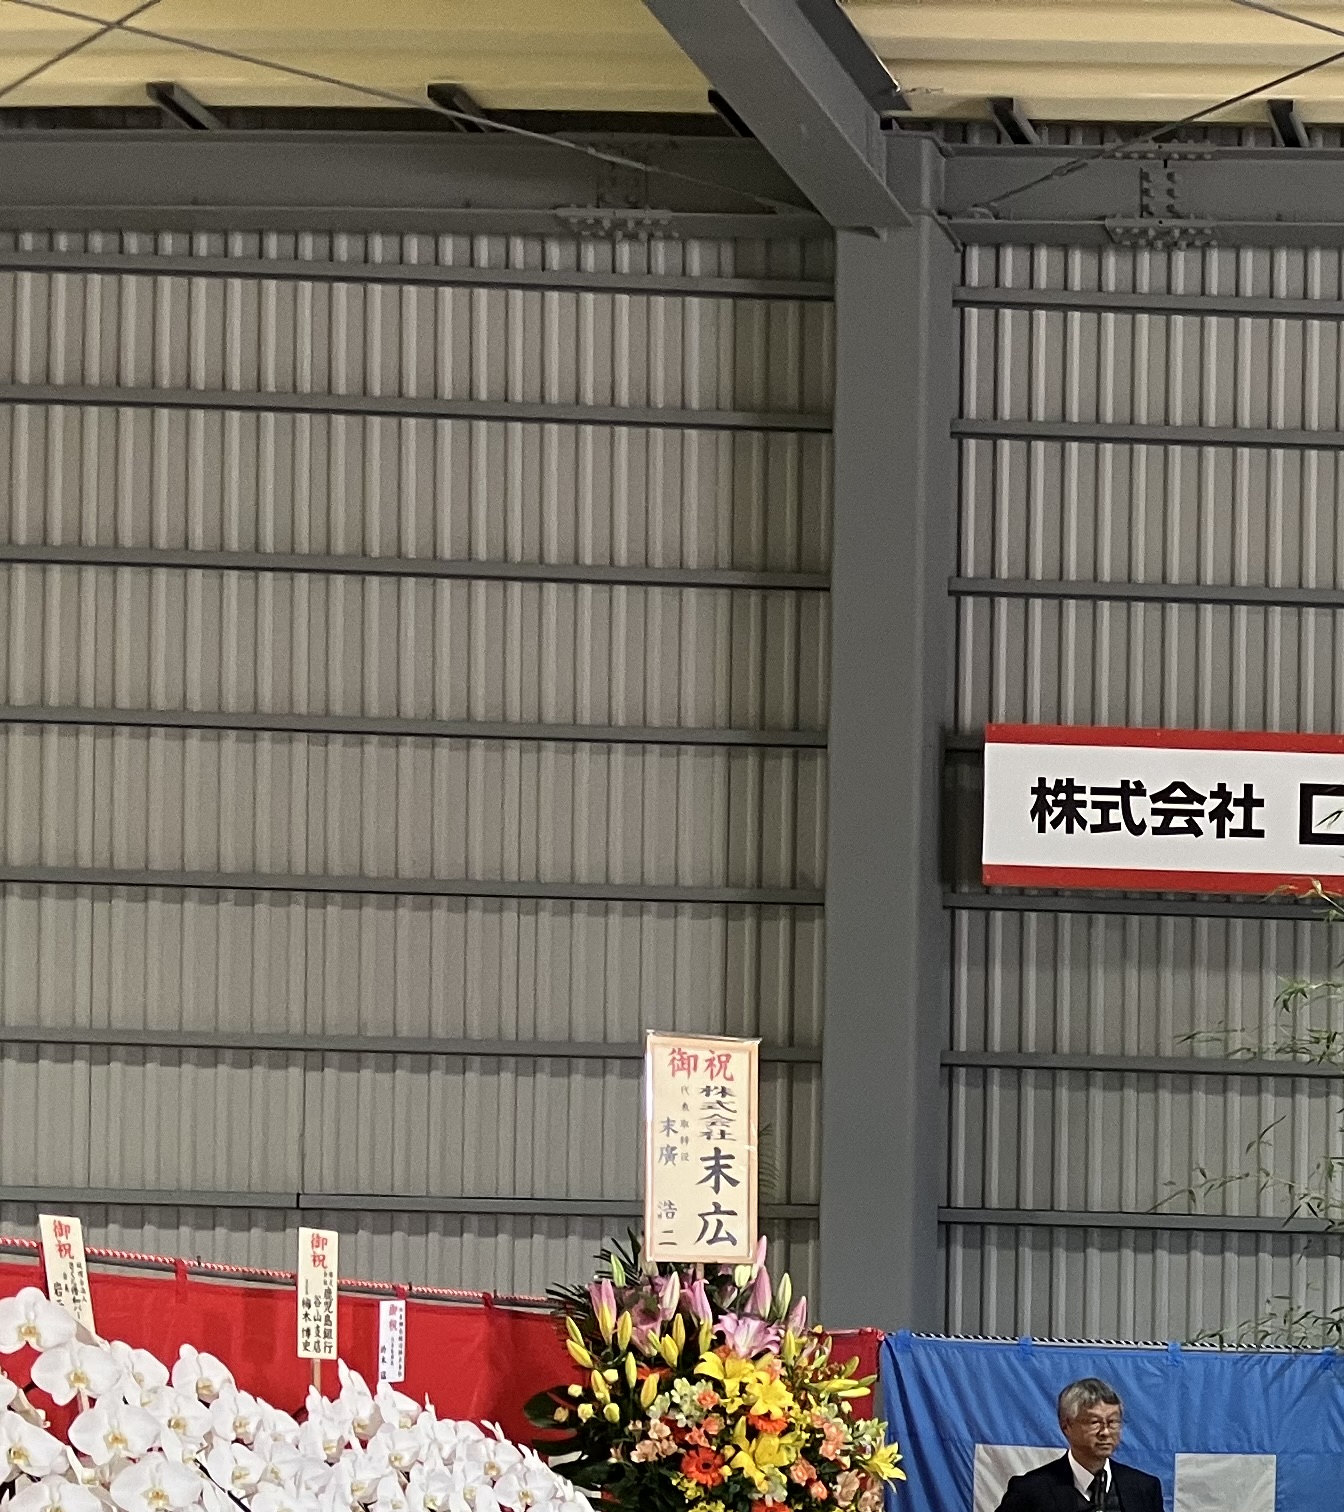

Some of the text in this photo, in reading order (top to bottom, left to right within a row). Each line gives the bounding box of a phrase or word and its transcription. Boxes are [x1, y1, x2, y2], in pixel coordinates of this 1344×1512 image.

[1030, 776, 1265, 841] 株式会社
[667, 1048, 734, 1082] 御祝
[695, 1085, 740, 1246] 株式会社末広
